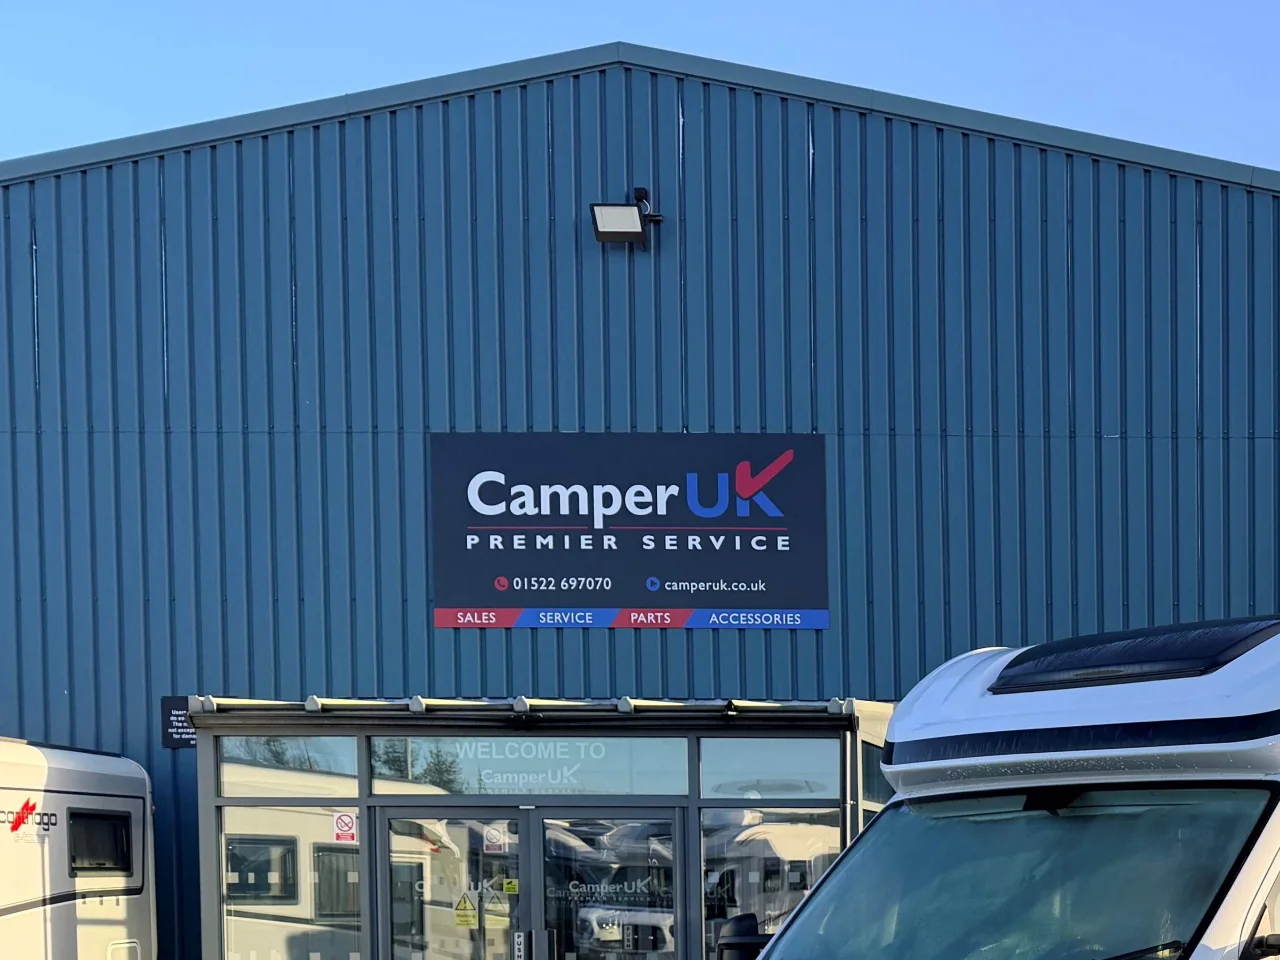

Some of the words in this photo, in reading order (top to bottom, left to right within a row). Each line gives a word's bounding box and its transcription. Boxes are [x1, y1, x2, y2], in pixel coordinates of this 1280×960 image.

[466, 535, 618, 550] PREMIER
[642, 535, 790, 551] SERVICE
[513, 577, 556, 590] 01522
[560, 577, 612, 590] 697070
[664, 579, 767, 593] camperuk.co.uk
[457, 612, 496, 624] SALES
[539, 612, 593, 624] SERVICE
[630, 612, 671, 624] PARTS
[709, 613, 801, 625] ACCESSORIES
[455, 742, 570, 759] WELCOME
[576, 742, 606, 759] TO
